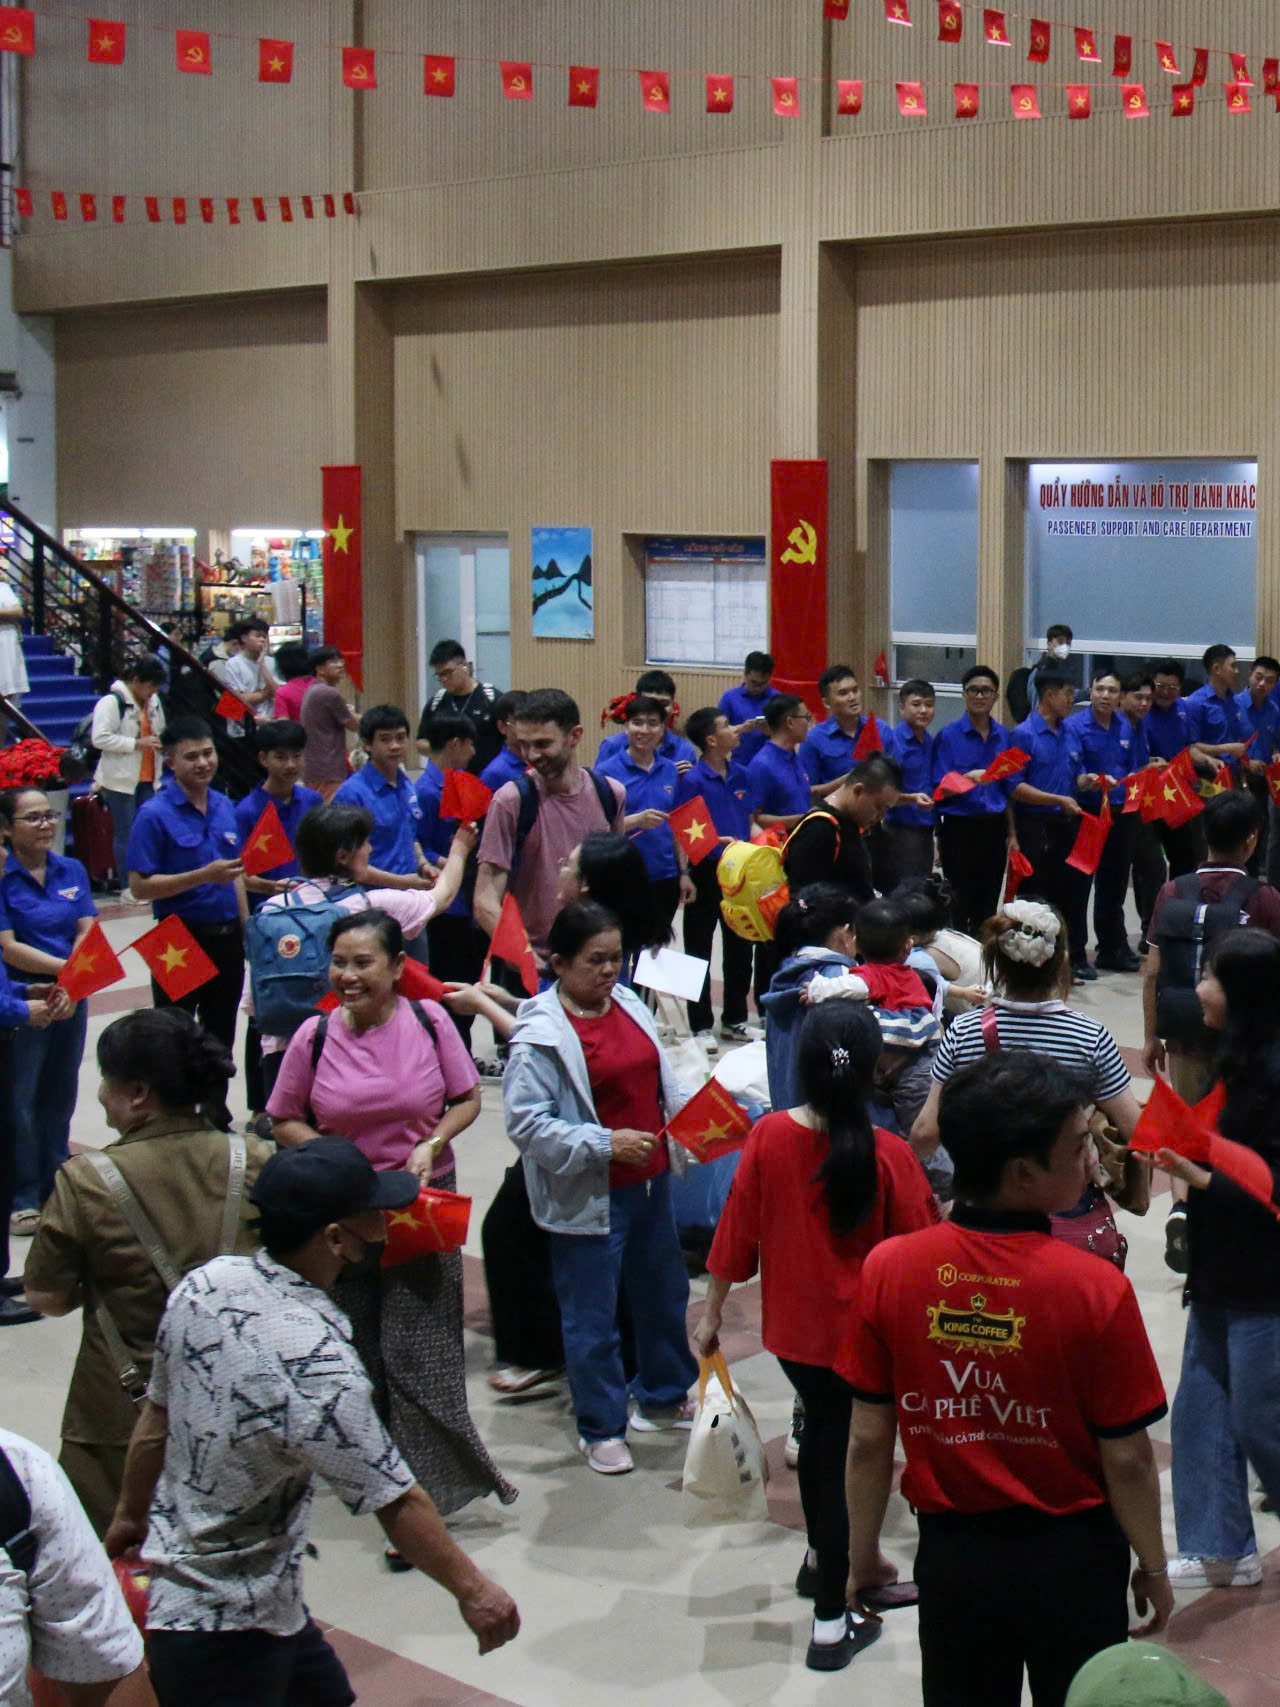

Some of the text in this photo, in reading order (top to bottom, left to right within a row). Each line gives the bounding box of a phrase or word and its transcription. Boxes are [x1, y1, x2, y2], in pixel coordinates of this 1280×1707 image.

[1169, 480, 1189, 512] TRỢ
[1193, 480, 1223, 510] HÀNH
[1047, 520, 1252, 537] PASSENGER SUPPORT AND CARE DEPARTMENT
[958, 1271, 1021, 1288] CORPORATION
[943, 1321, 1009, 1339] KING COFFEE
[934, 1394, 983, 1420] PHÊ
